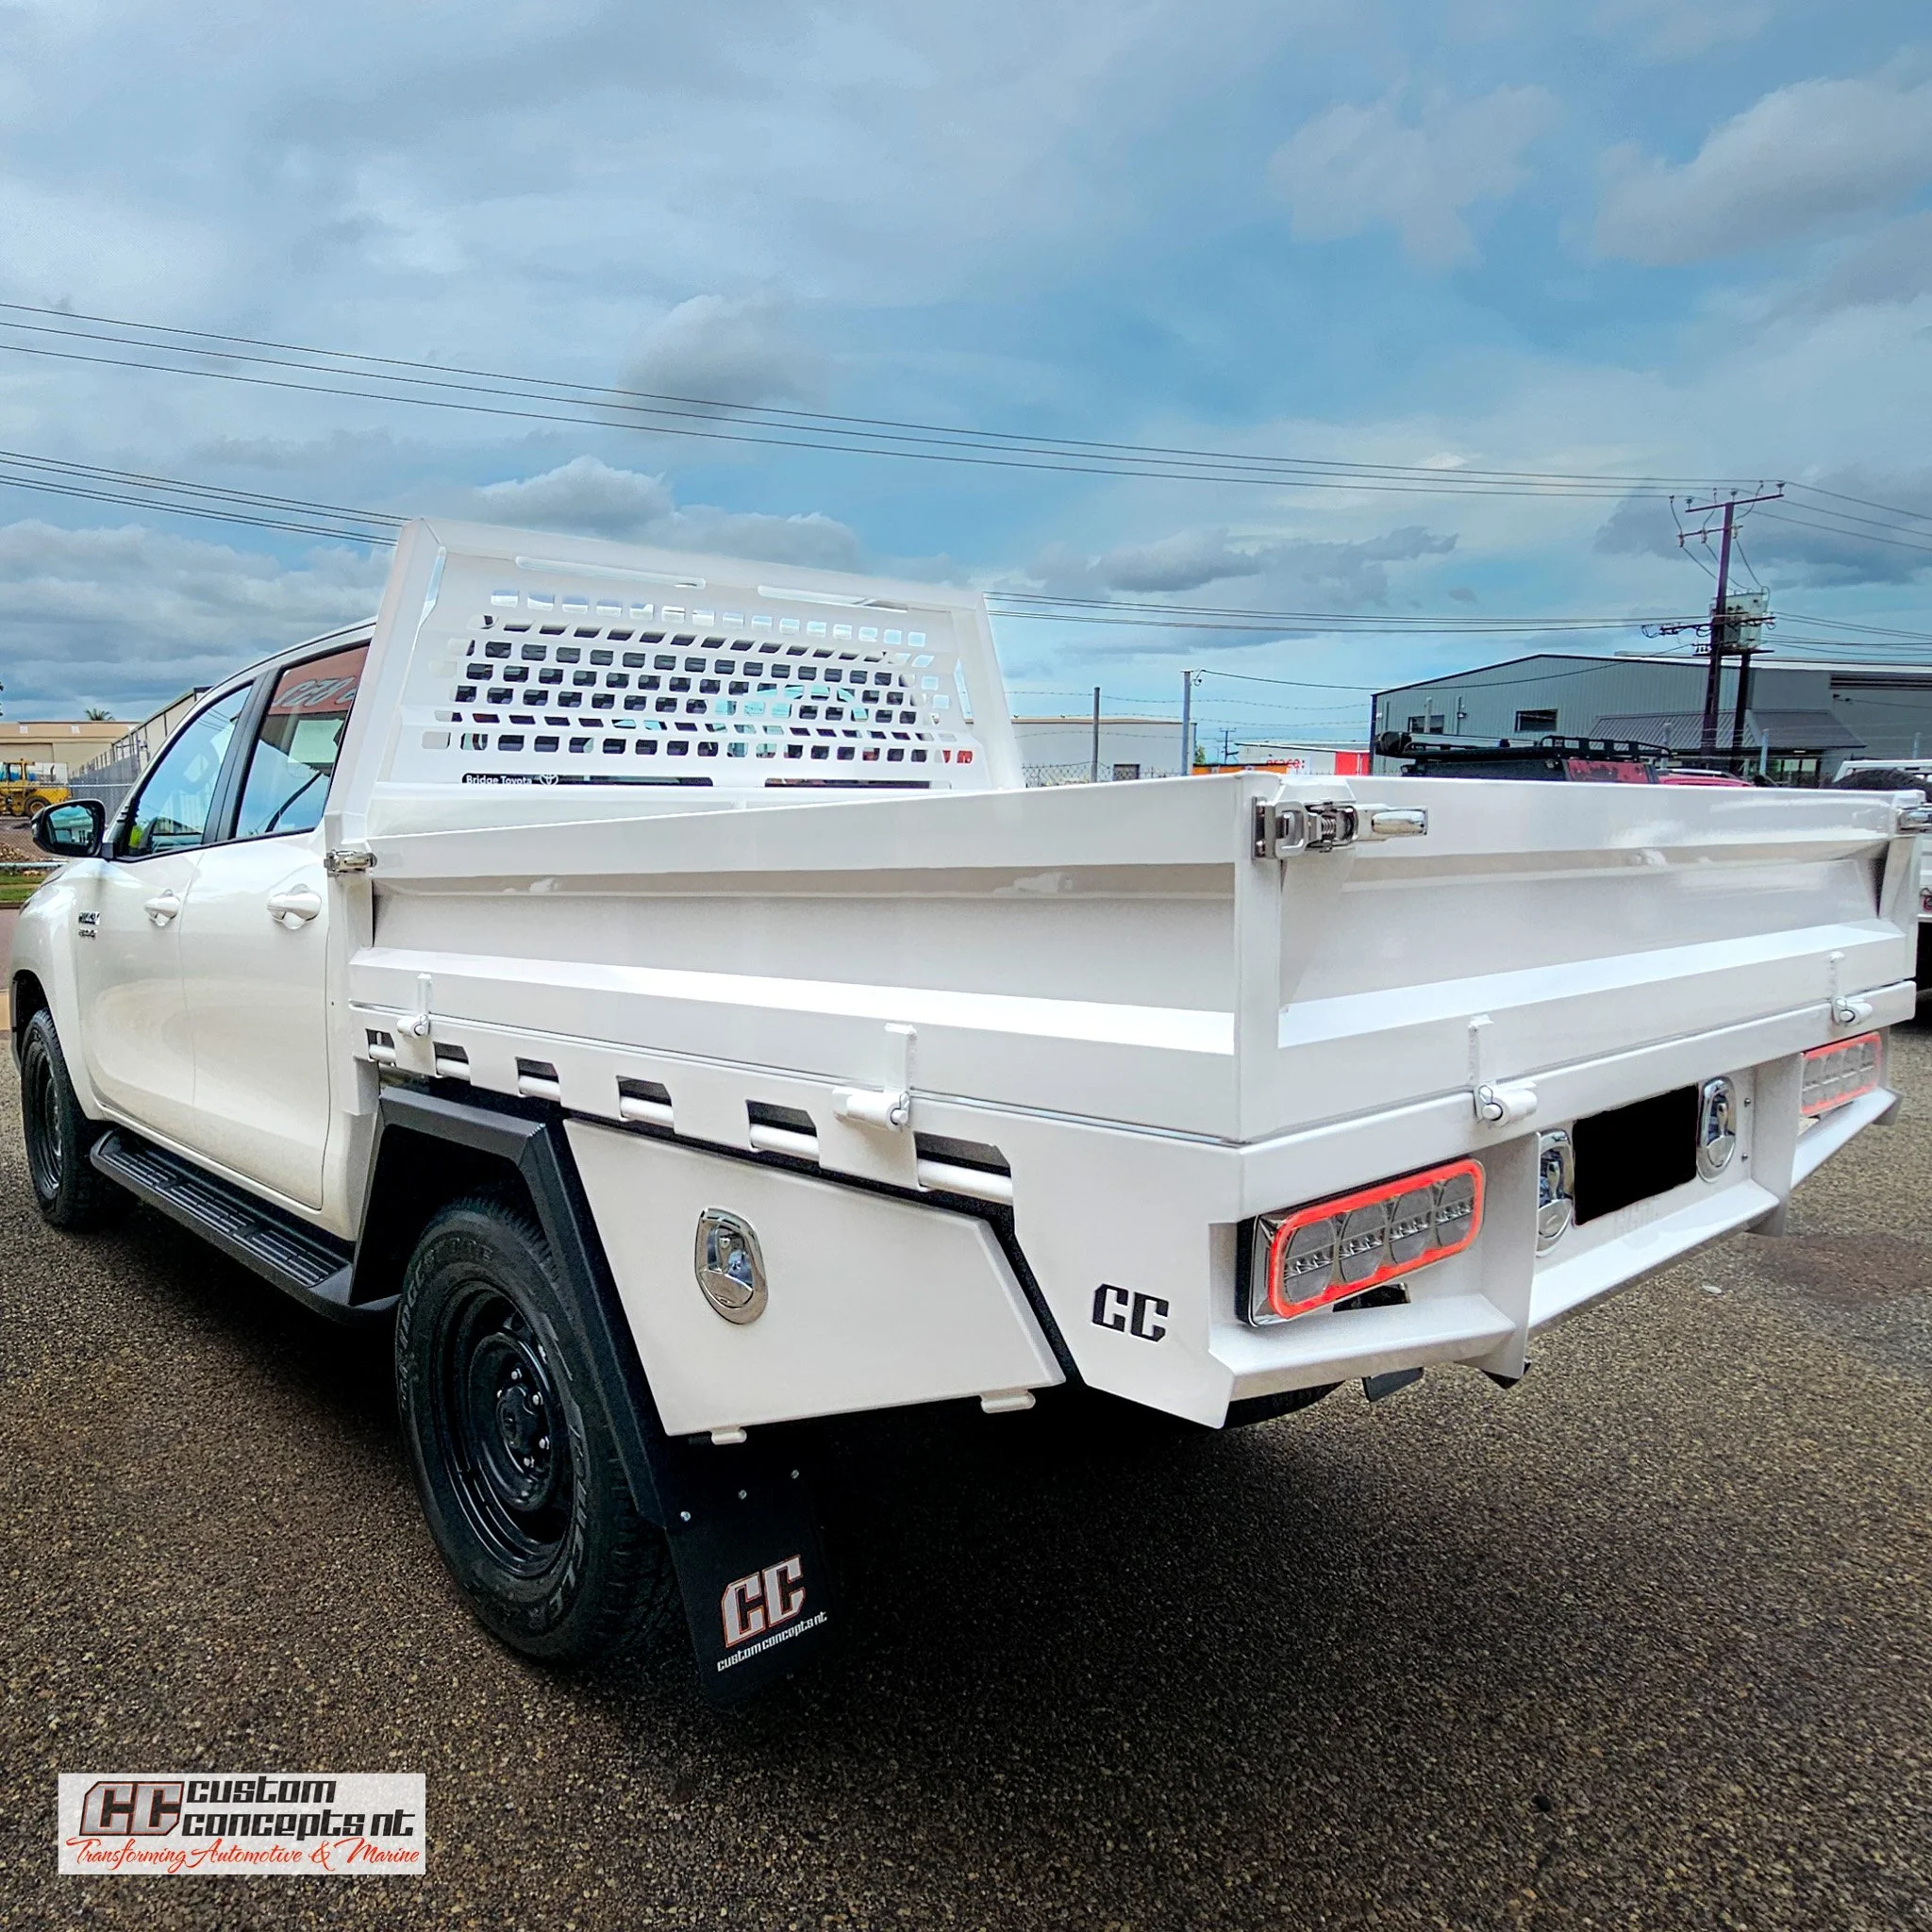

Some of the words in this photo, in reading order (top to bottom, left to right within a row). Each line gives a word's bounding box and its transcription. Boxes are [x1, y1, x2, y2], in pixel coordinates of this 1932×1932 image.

[466, 774, 498, 784] Bridge
[500, 775, 532, 784] Toyota
[1092, 1283, 1169, 1342] CC
[721, 1554, 806, 1648] CC
